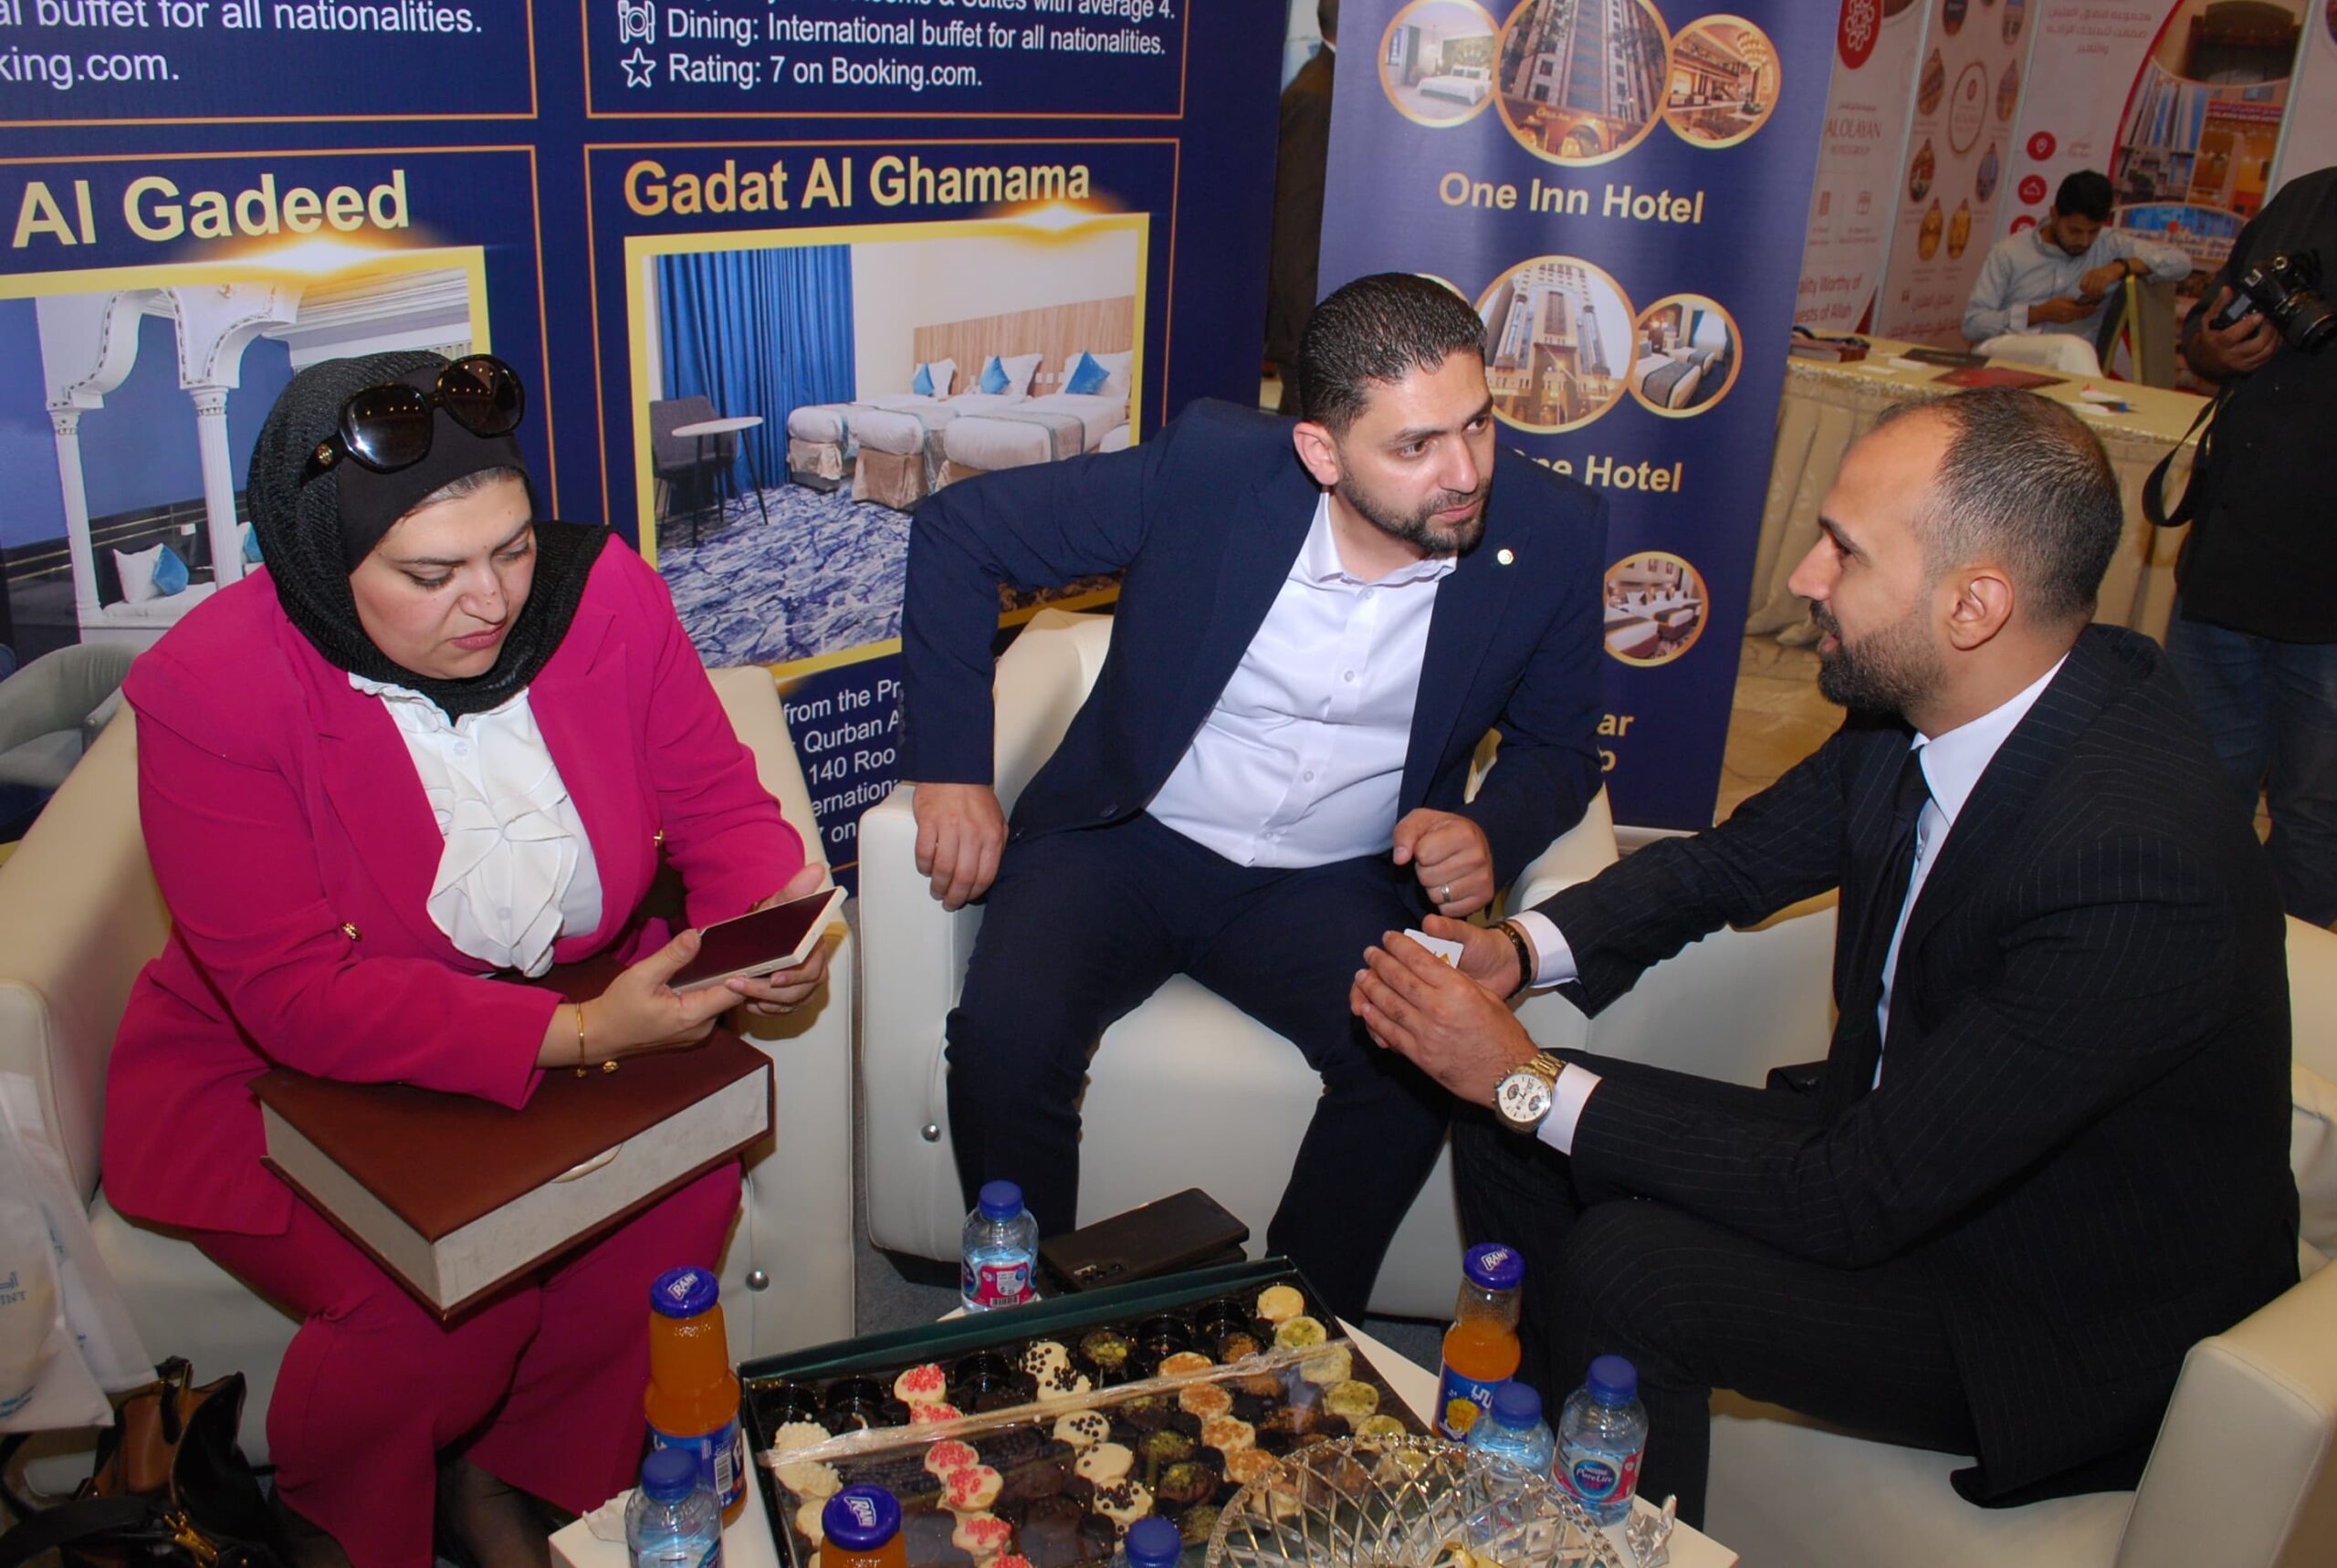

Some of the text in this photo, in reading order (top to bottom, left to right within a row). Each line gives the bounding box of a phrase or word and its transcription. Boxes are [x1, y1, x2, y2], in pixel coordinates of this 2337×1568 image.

[37, 0, 150, 27] buffet
[158, 0, 210, 28] for
[222, 0, 262, 28] all
[274, 0, 482, 33] nationalities.
[668, 8, 1166, 55] Dining: International buffet for all nationalities.
[669, 53, 982, 91] Rating: 7 on Booking.com.
[624, 155, 1090, 216] Gadat Al Ghamama
[1439, 172, 1704, 224] One Inn Hotel
[12, 169, 409, 247] Al Gadeed
[1585, 455, 1683, 493] Hotel
[784, 698, 832, 725] from
[837, 689, 871, 712] the
[803, 722, 883, 753] Qurban
[809, 747, 896, 785] 140 Roo
[812, 779, 898, 817] ernation
[831, 821, 856, 842] on
[1482, 1249, 1508, 1270] RANI
[668, 1272, 697, 1299] RANI
[846, 1498, 875, 1526] RANI
